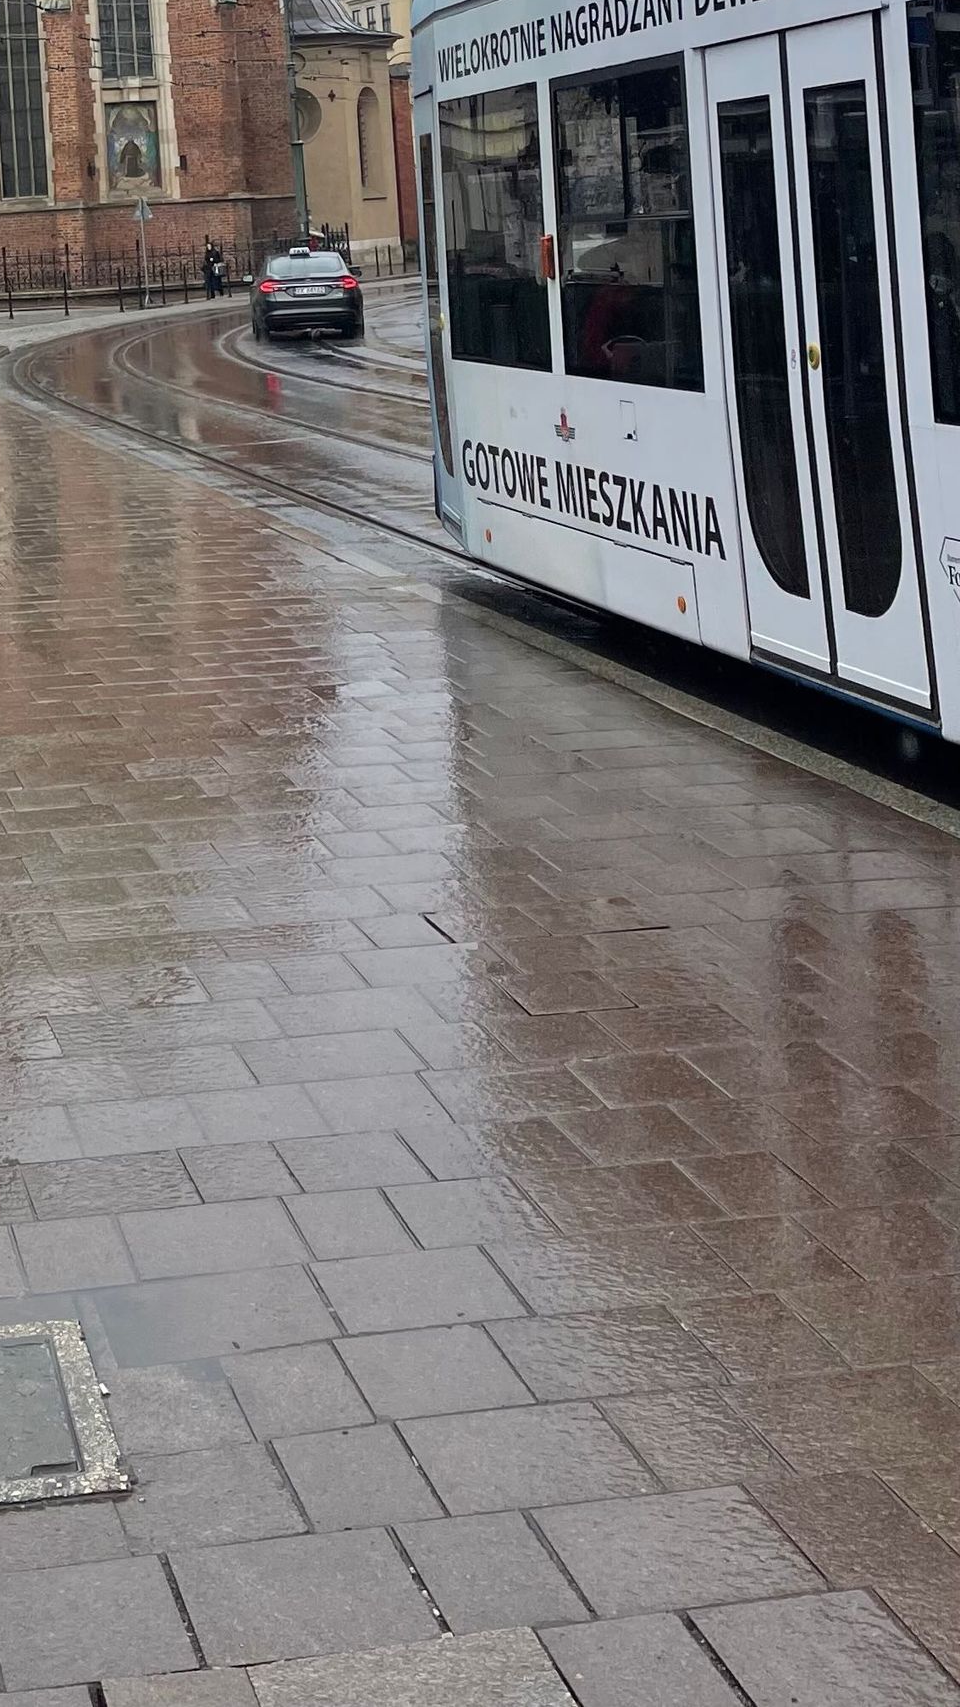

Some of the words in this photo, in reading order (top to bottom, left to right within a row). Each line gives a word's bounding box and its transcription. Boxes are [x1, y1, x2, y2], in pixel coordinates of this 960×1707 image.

[438, 18, 547, 83] WIELOKROTNIE
[462, 439, 551, 510] GOTOWE
[555, 460, 727, 562] MIESZKANIA
